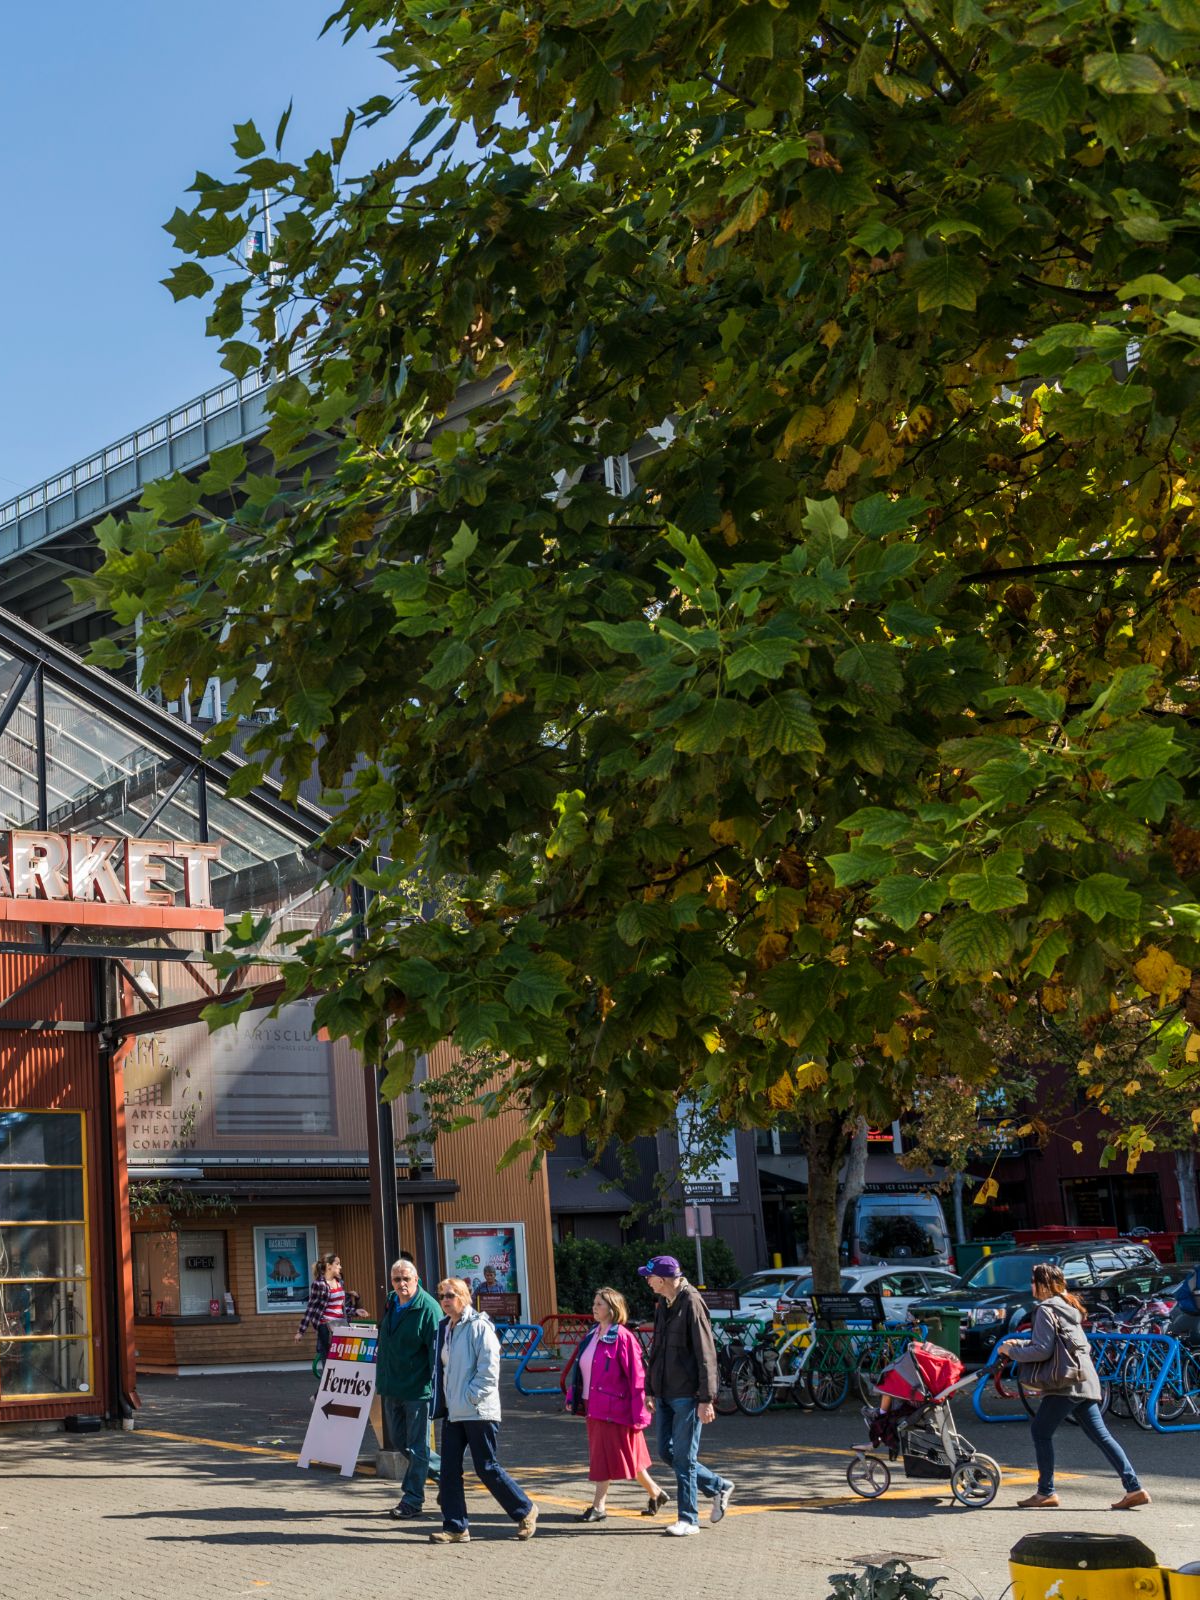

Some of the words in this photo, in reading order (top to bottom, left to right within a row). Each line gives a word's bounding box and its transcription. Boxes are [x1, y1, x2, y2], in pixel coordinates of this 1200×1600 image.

[244, 1029, 320, 1042] ARTSCLU
[132, 1109, 197, 1121] ARTSCLUB
[133, 1140, 198, 1150] COMPANY
[188, 1257, 215, 1268] OPEN
[322, 1368, 373, 1397] Ferries
